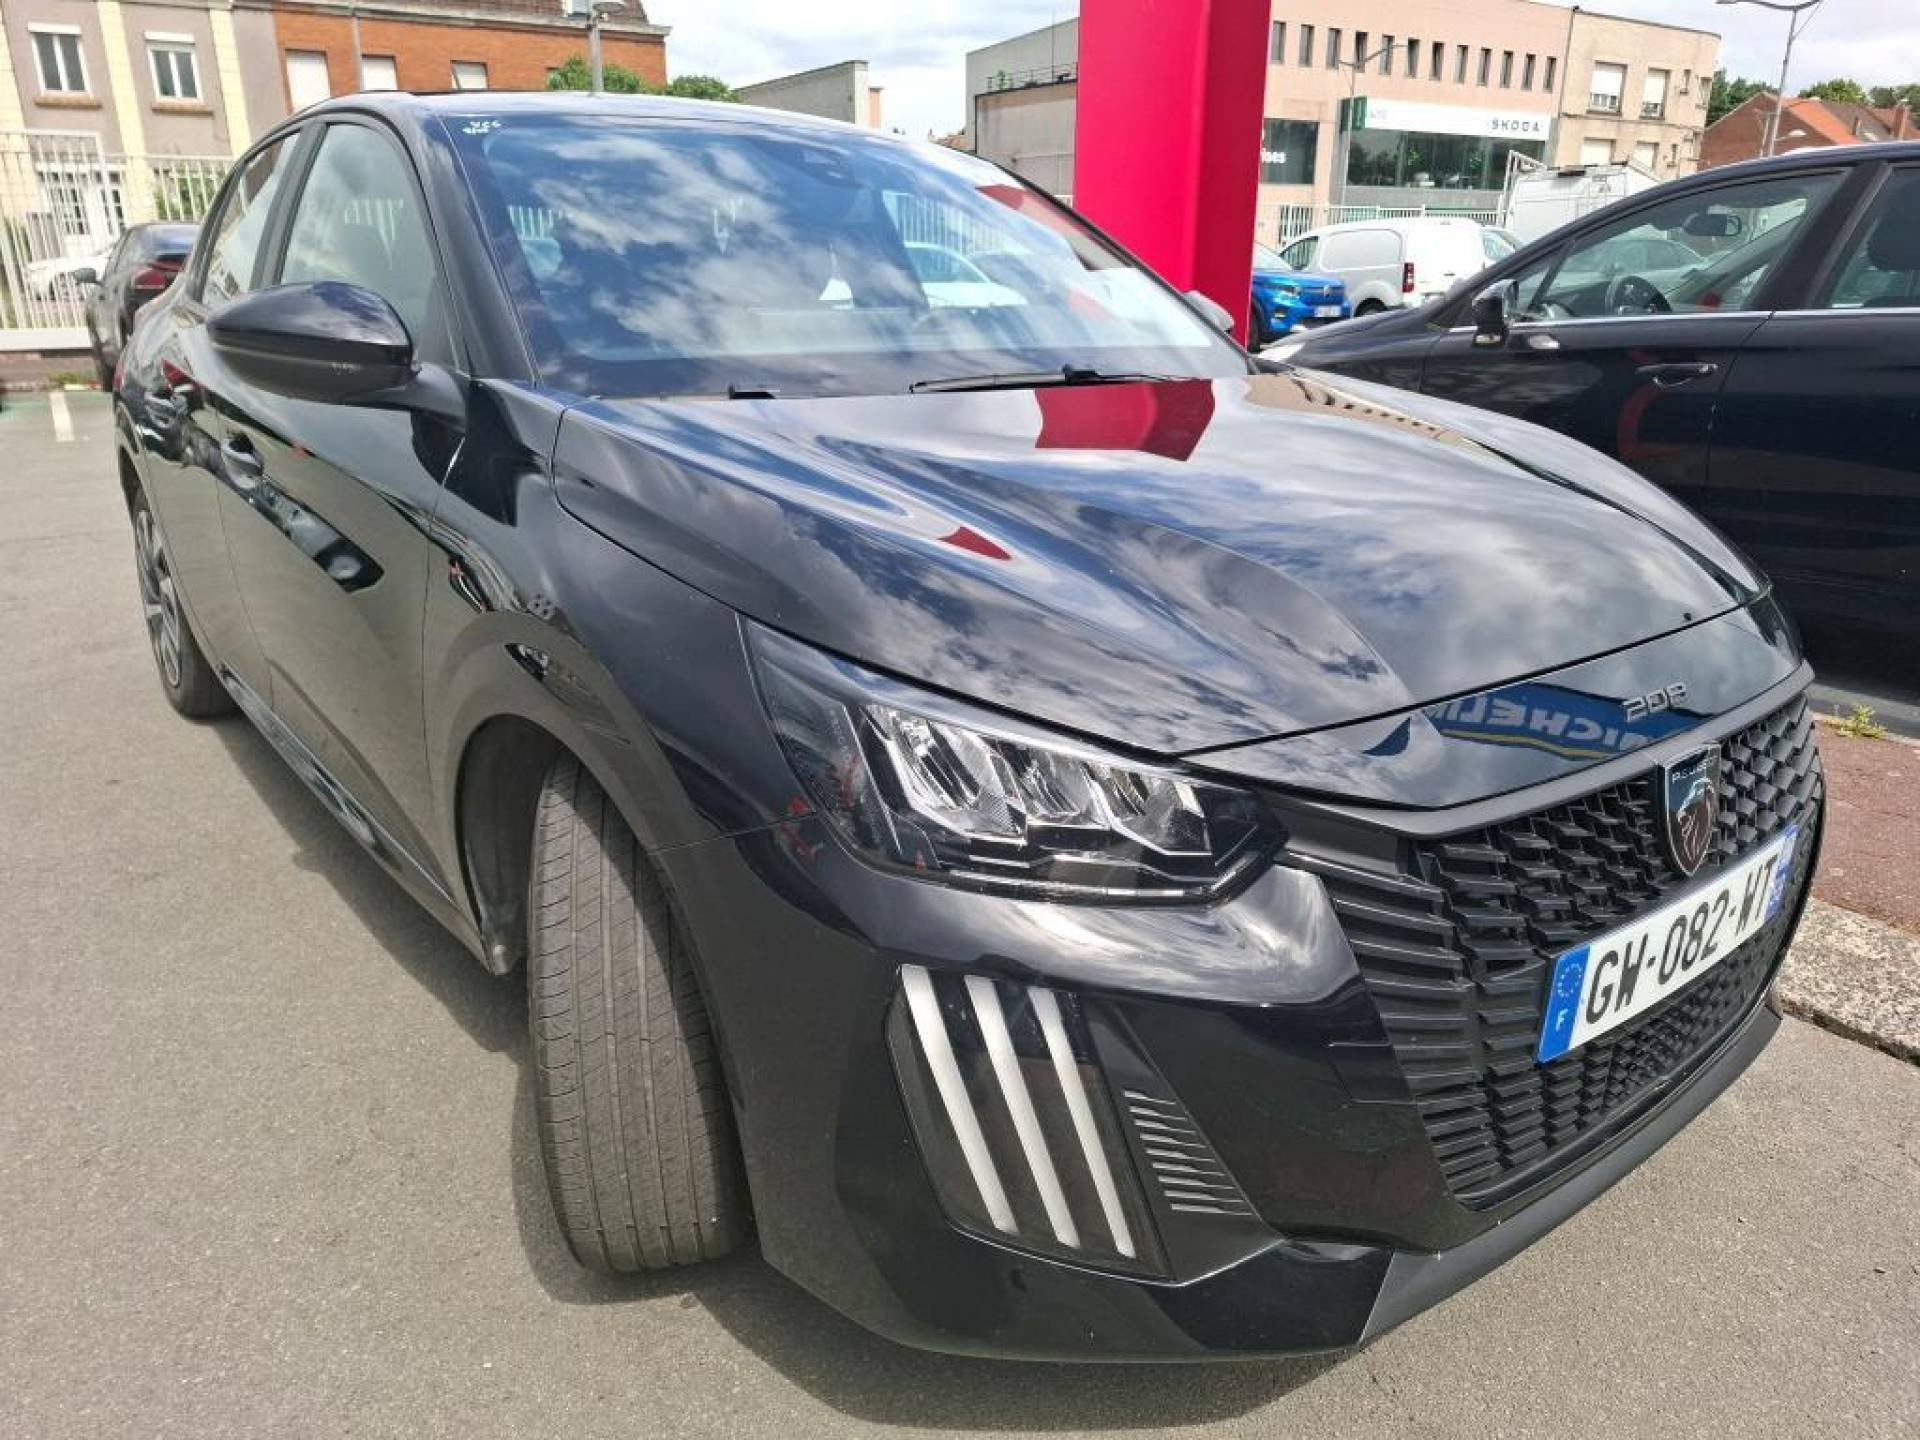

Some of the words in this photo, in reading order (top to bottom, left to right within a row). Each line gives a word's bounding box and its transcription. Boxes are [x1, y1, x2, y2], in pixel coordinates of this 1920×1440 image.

[1622, 681, 1688, 722] 208
[1586, 853, 1778, 1024] GW-082-WT
[1555, 1008, 1568, 1031] F
